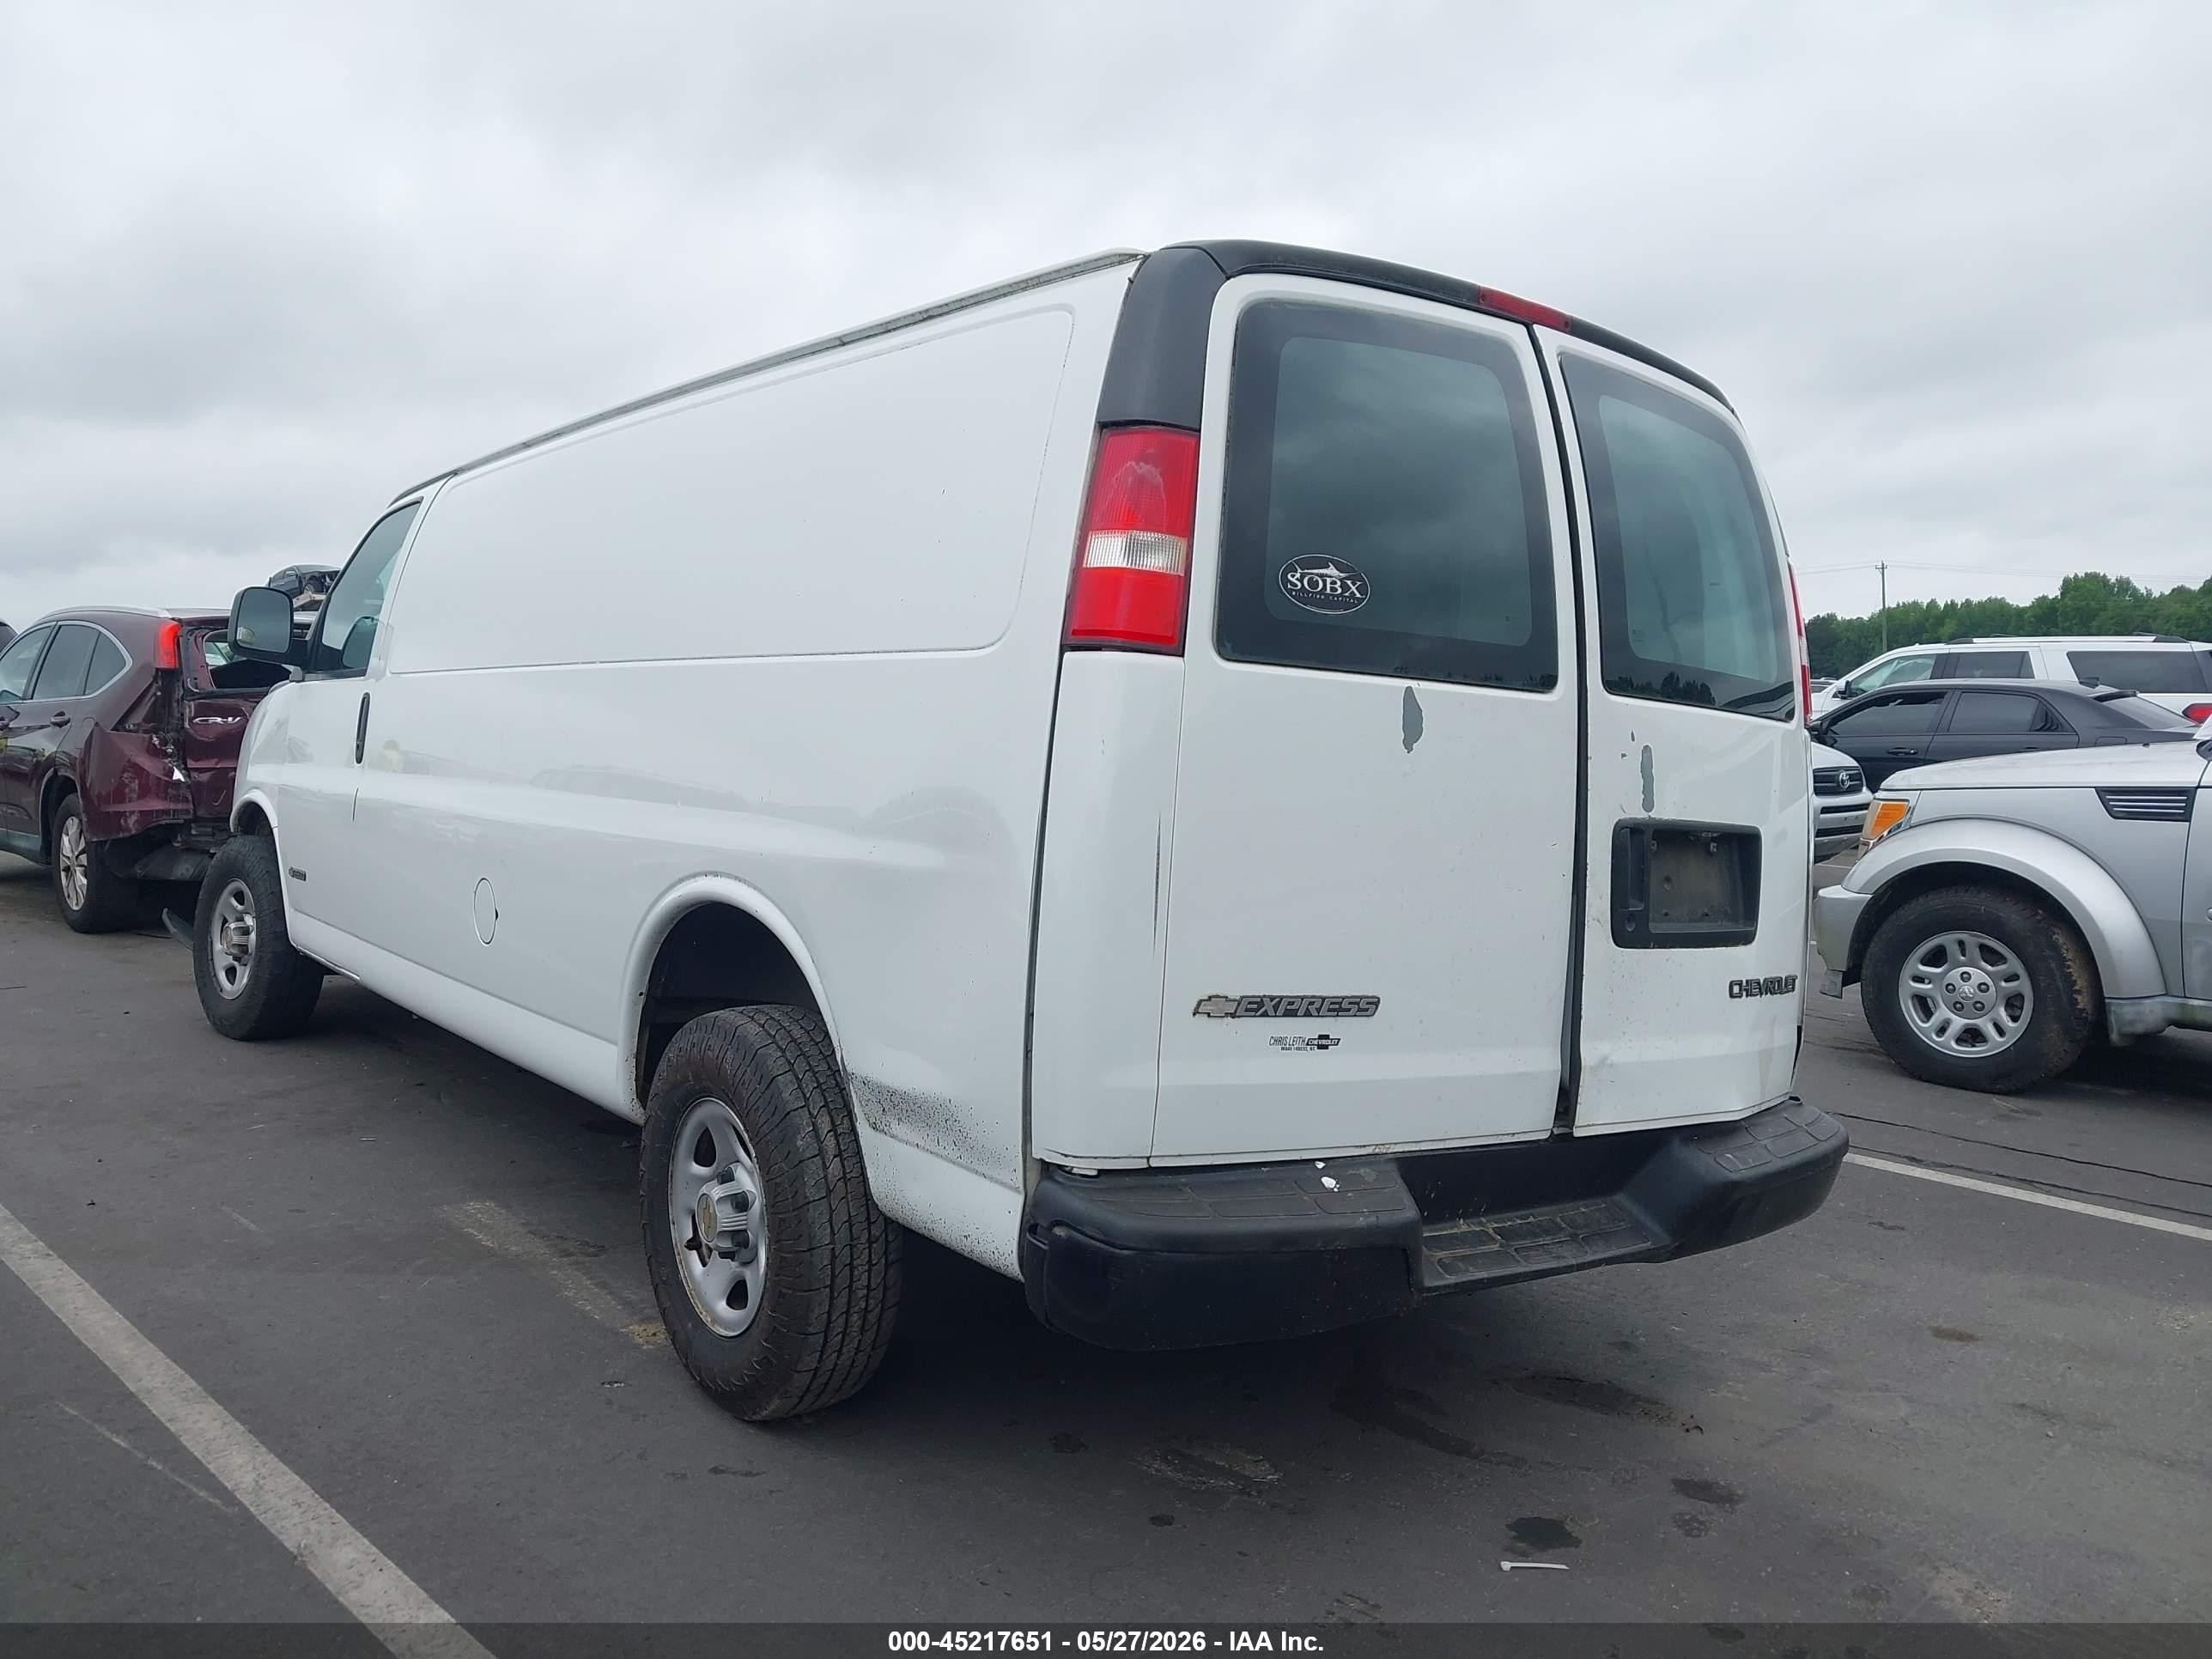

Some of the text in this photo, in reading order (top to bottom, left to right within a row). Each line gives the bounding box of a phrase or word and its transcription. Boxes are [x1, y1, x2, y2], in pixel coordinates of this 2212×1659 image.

[1286, 572, 1364, 599] SOBX
[191, 716, 242, 725] CR-V
[1729, 974, 1798, 999] CHEVROLET
[1236, 996, 1380, 1018] EXPRESS
